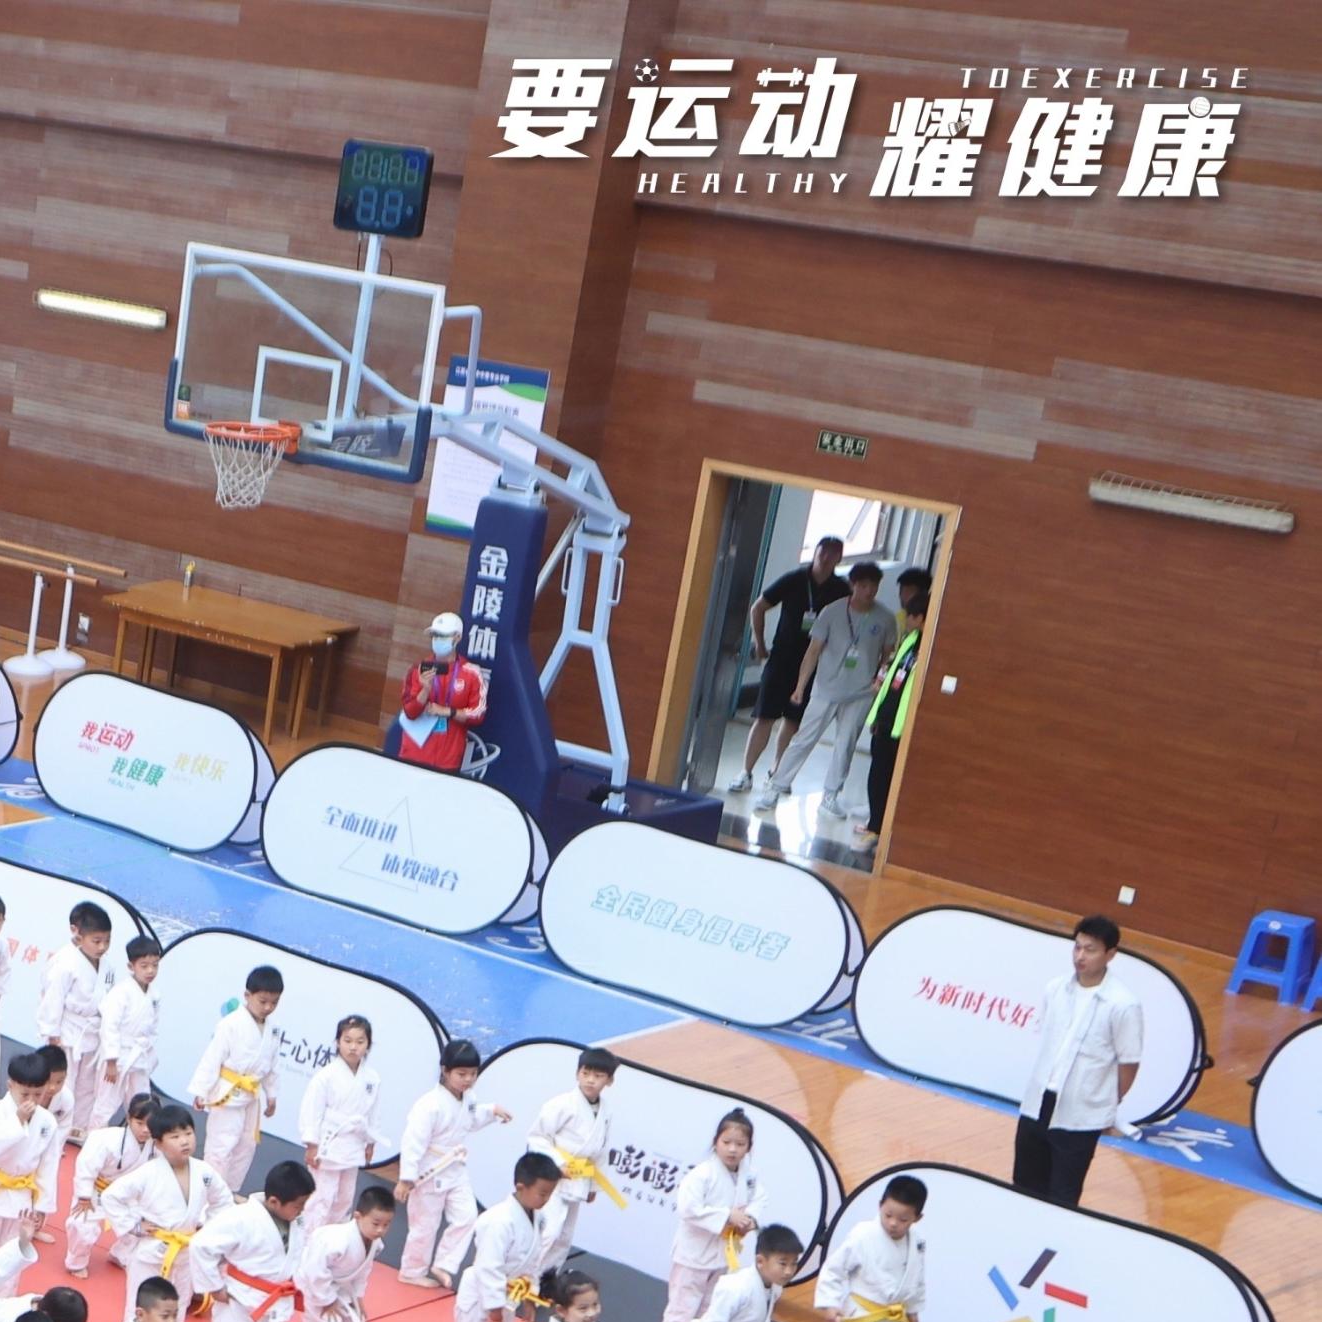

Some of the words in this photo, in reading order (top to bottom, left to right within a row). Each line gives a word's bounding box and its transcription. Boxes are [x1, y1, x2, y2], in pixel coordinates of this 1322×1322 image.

[111, 756, 167, 787] 我健康
[591, 884, 791, 962] 全民健身倡导者
[914, 976, 1042, 1034] 为新时代好
[608, 1144, 697, 1194] 嘭嘭
